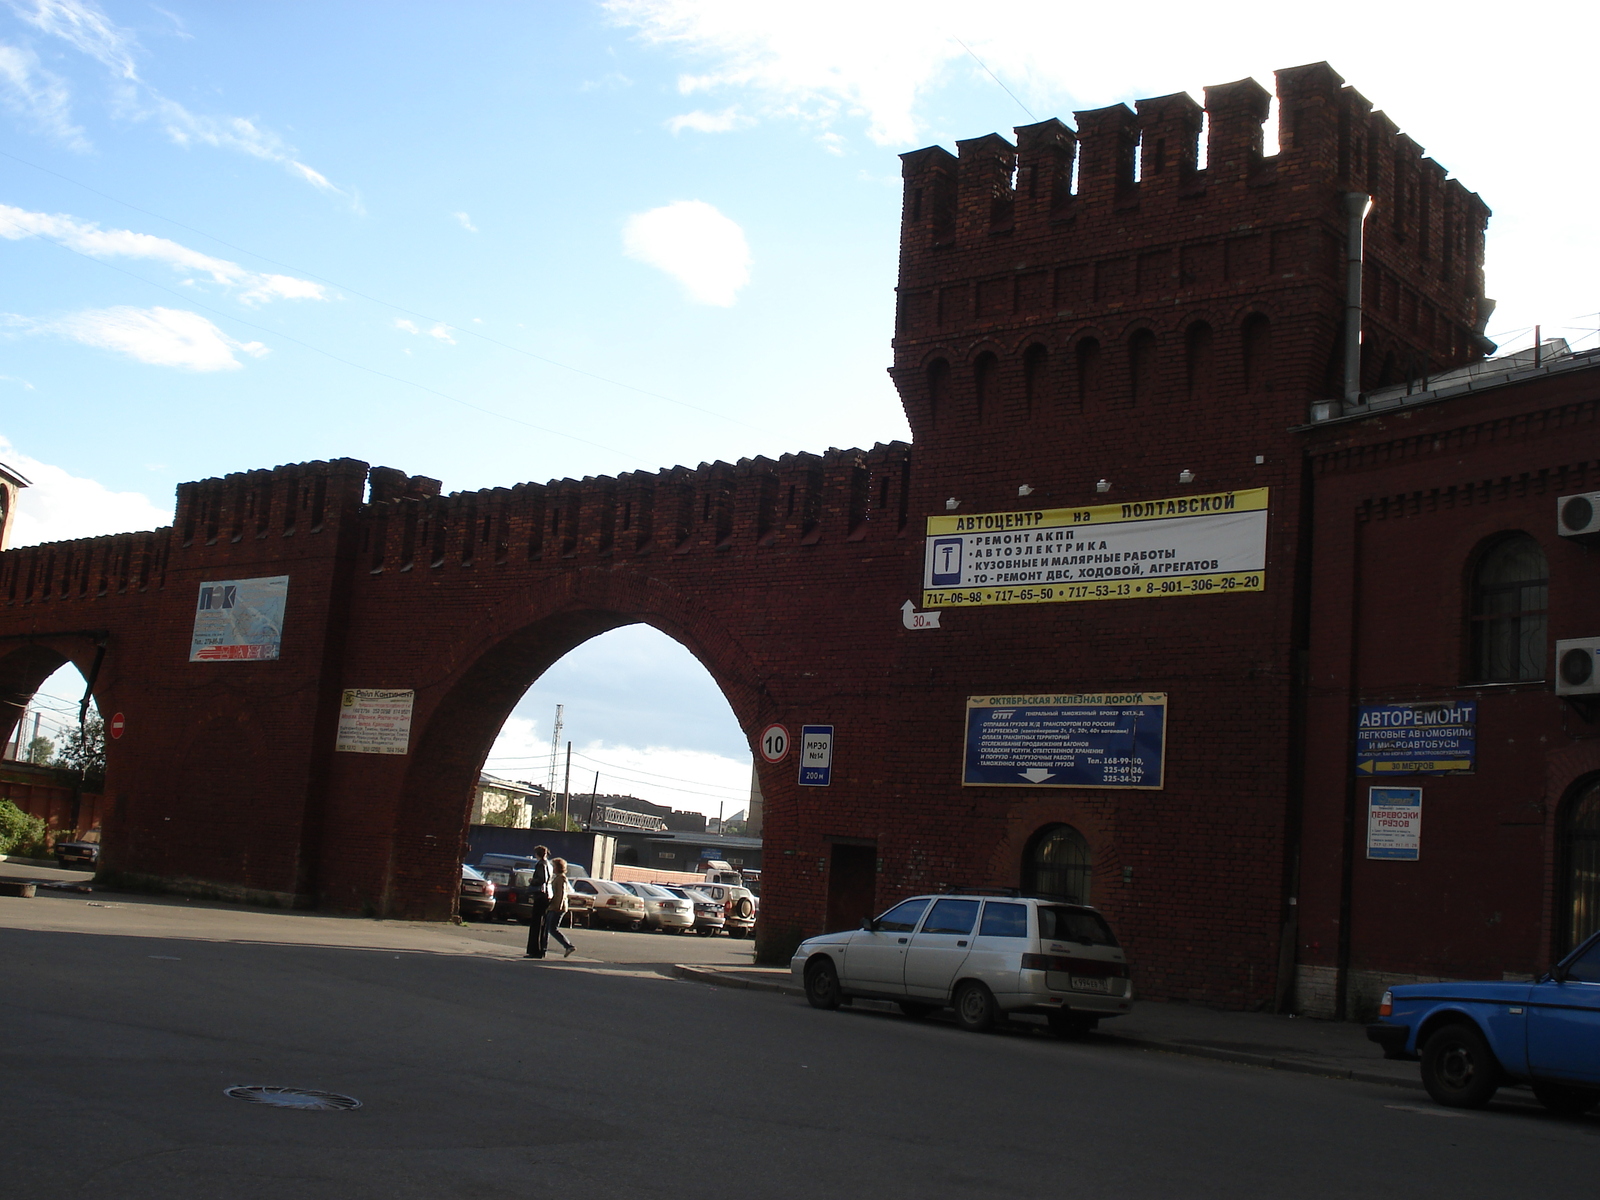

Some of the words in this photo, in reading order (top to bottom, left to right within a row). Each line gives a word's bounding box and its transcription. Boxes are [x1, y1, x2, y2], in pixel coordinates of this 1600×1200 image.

[956, 512, 1044, 531] АВТОЦЕНТР
[1073, 512, 1091, 522] на
[1122, 491, 1235, 518] ПОЛТАВСКОЙ
[976, 533, 1030, 546] РЕМОНТ
[1036, 530, 1074, 542] АКПП
[975, 541, 1108, 558] АВТОЭЛЕКТРИКА
[975, 558, 1038, 570] КУЗОВНЫЕ
[1040, 558, 1048, 567] И
[1051, 553, 1121, 566] МАЛЯРНЫЕ
[1124, 549, 1176, 562] РАБОТЫ
[1046, 569, 1074, 582] ДВС,
[1078, 562, 1144, 578] ХОДОВОЙ,
[1149, 560, 1219, 574] АГРЕГАТОВ
[926, 592, 982, 604] 717-06-98
[994, 588, 1054, 602] 717-65-50
[1068, 584, 1130, 598] 717-53-13
[1146, 576, 1260, 594] 8-901-306-26-20
[913, 615, 924, 628] 30
[989, 696, 1050, 705] ОКТЯБРЬСКАЯ
[1053, 696, 1102, 704] ЖЕЛЕЗНАЯ
[1105, 695, 1143, 704] ДОРОГА
[1360, 707, 1472, 727] АВТОРЕМОНТ
[1358, 730, 1406, 740] ЛЕГКОВЫЕ
[1408, 728, 1472, 738] АВТОМОБИЛИ
[766, 736, 784, 754] 10
